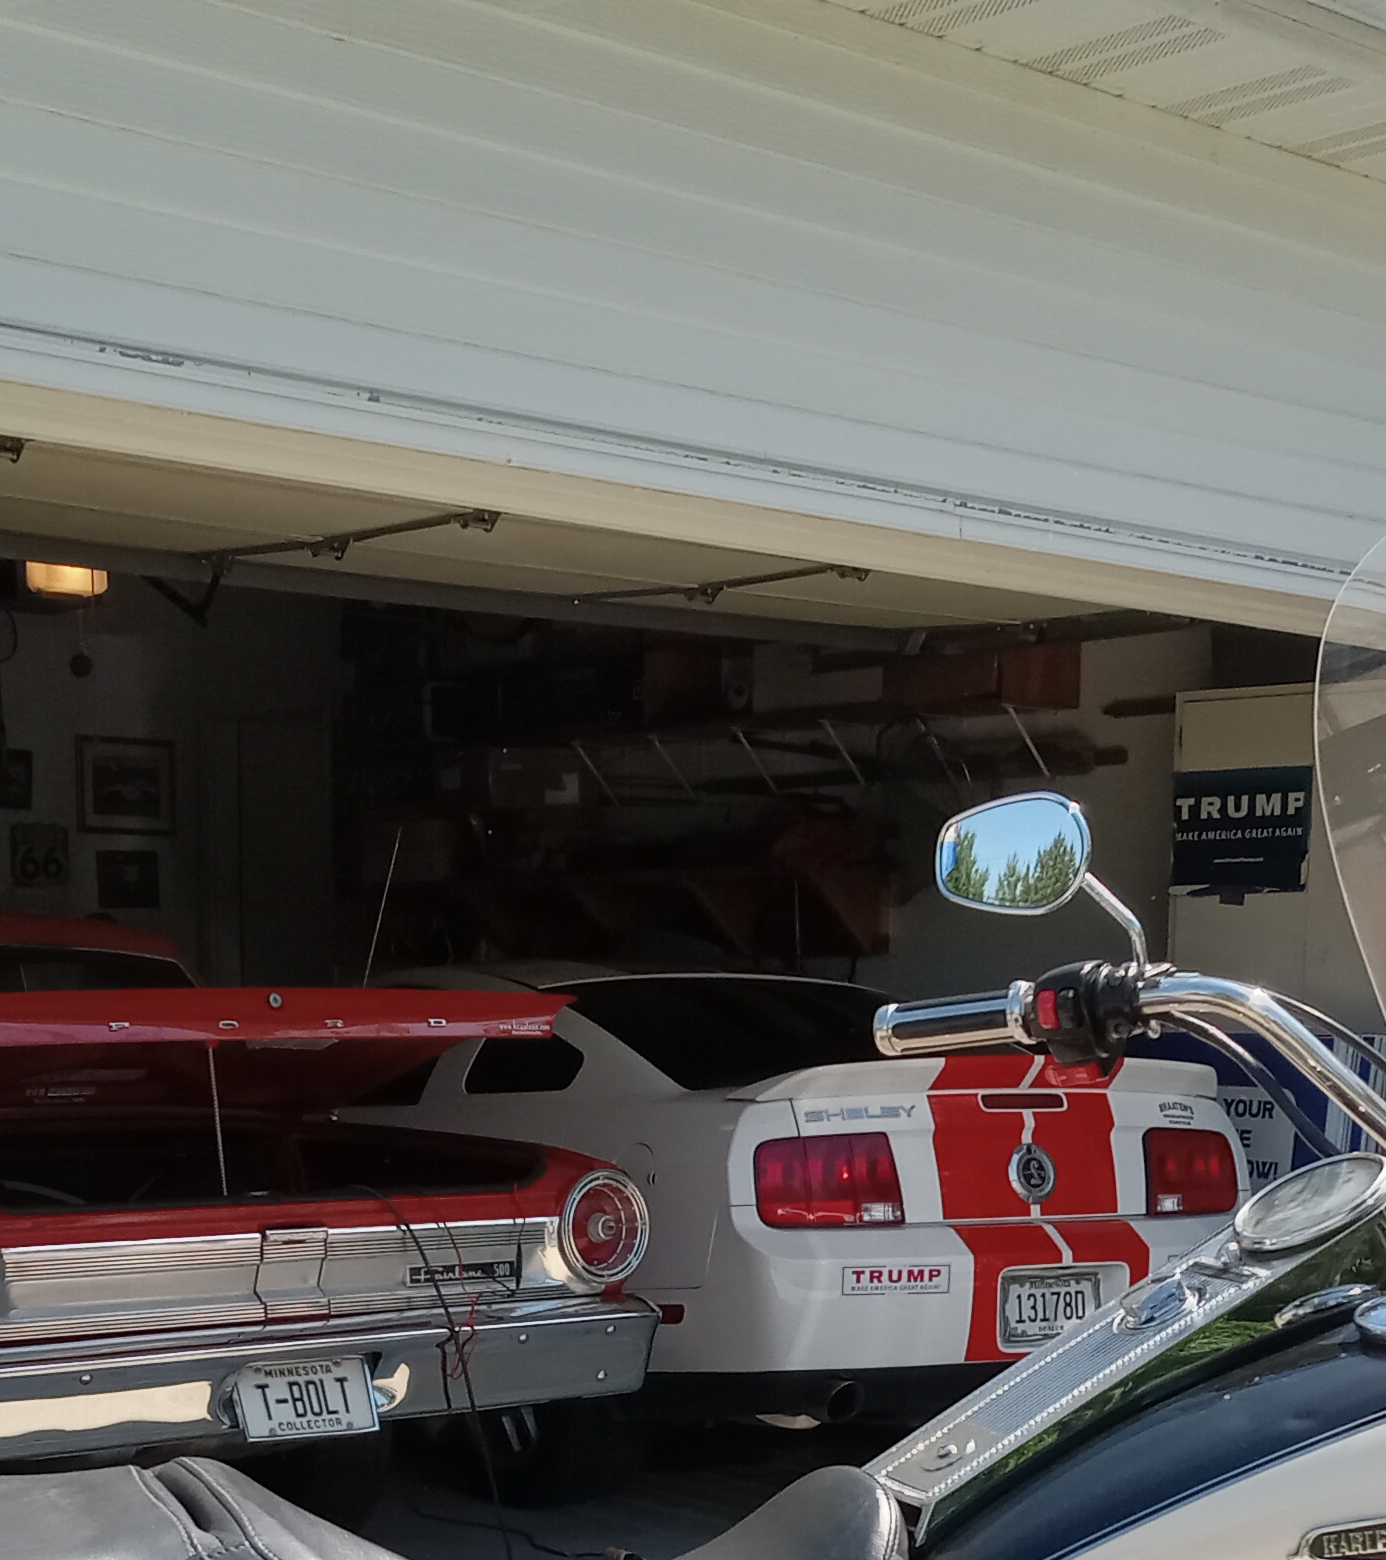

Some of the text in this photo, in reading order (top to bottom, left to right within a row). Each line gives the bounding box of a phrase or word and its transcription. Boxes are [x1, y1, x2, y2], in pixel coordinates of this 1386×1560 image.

[1176, 792, 1305, 821] TRUMP
[1176, 828, 1198, 841] MAKE
[1201, 827, 1242, 840] AMERICA
[1244, 826, 1273, 839] GREAT
[20, 846, 63, 880] 66
[1224, 1098, 1275, 1119] YOUR
[493, 1262, 510, 1277] 500
[851, 1268, 942, 1284] TRUMP
[1015, 1290, 1086, 1324] 13178D
[264, 1363, 333, 1379] MINNESOTA
[254, 1376, 351, 1421] T-BOLT
[278, 1417, 343, 1432] COLLECTOR
